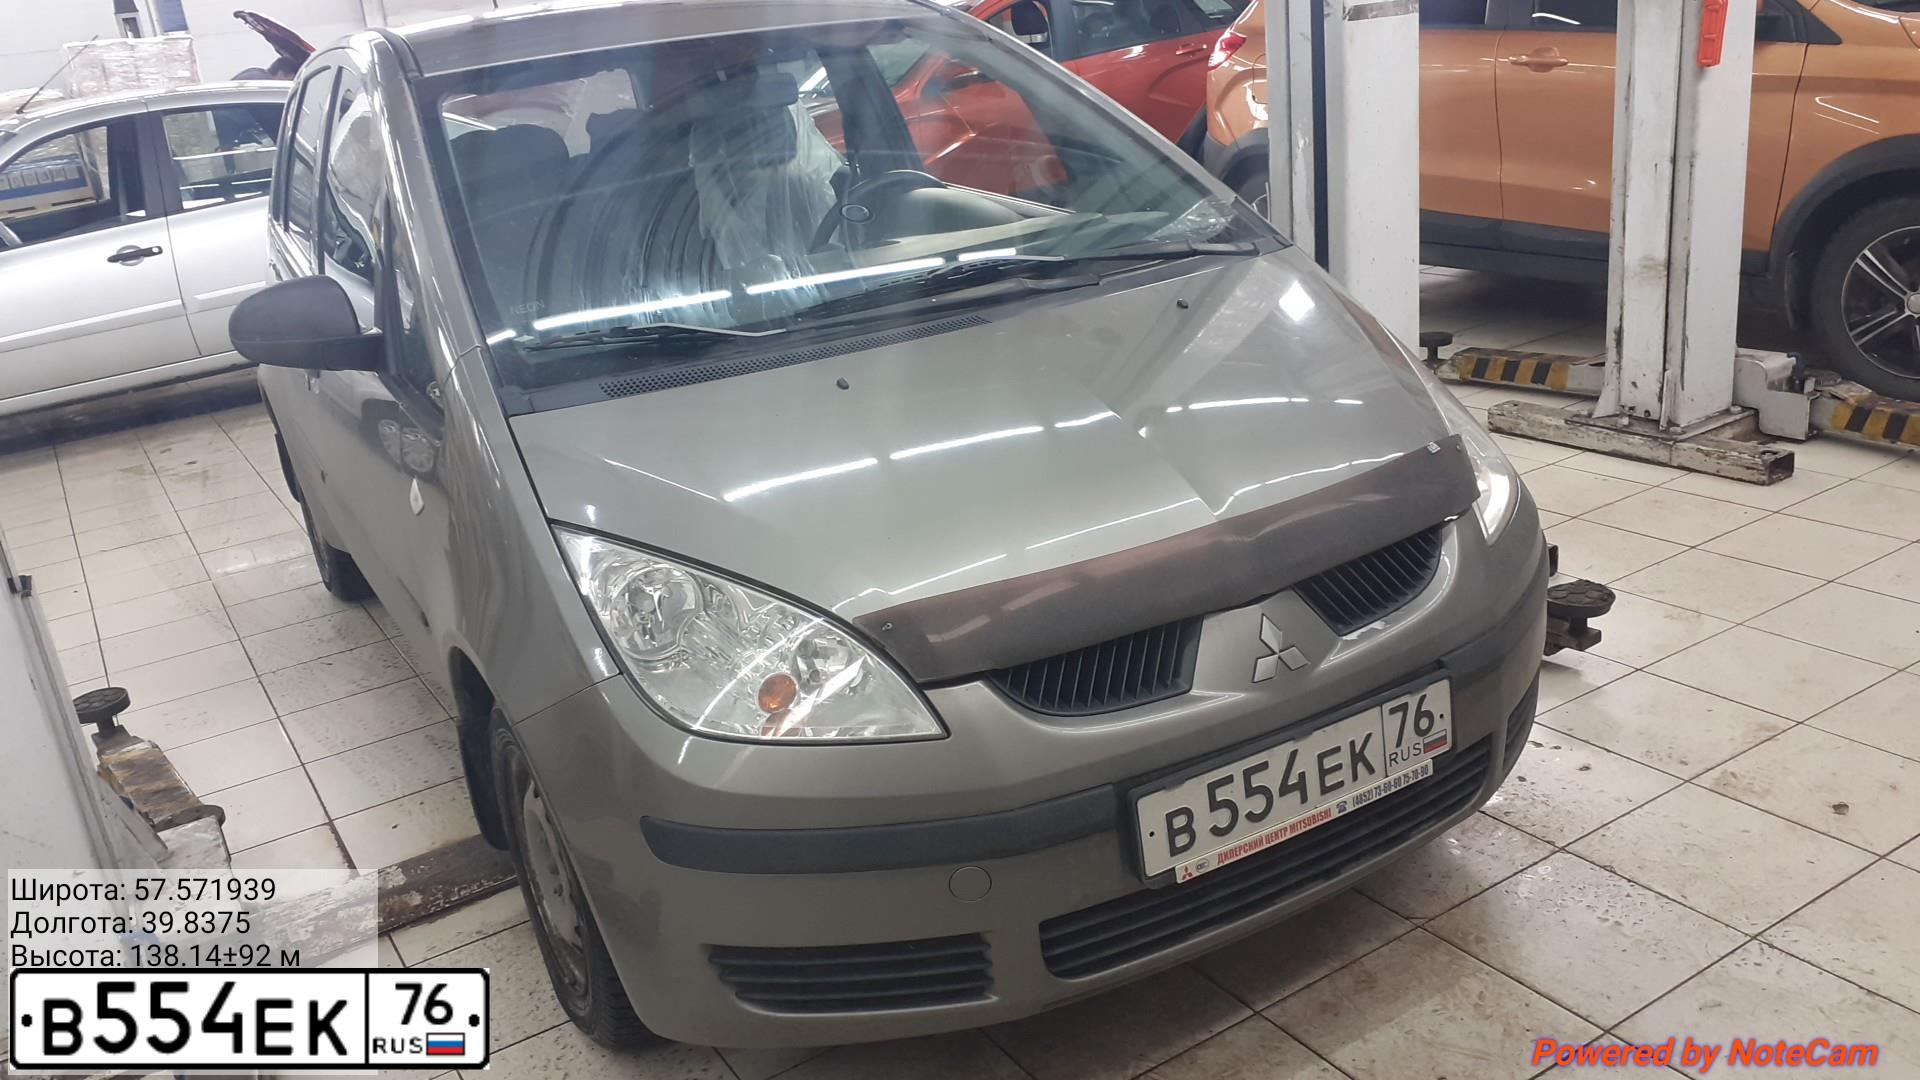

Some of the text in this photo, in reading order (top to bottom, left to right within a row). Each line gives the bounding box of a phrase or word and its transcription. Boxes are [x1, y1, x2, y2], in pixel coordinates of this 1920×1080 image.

[1388, 694, 1435, 749] 76
[1388, 742, 1422, 767] RUS
[1217, 836, 1264, 866] ДИЛЕРСКИЙ
[1265, 826, 1288, 846] ЦЕНТР
[1352, 792, 1374, 808] (4852)
